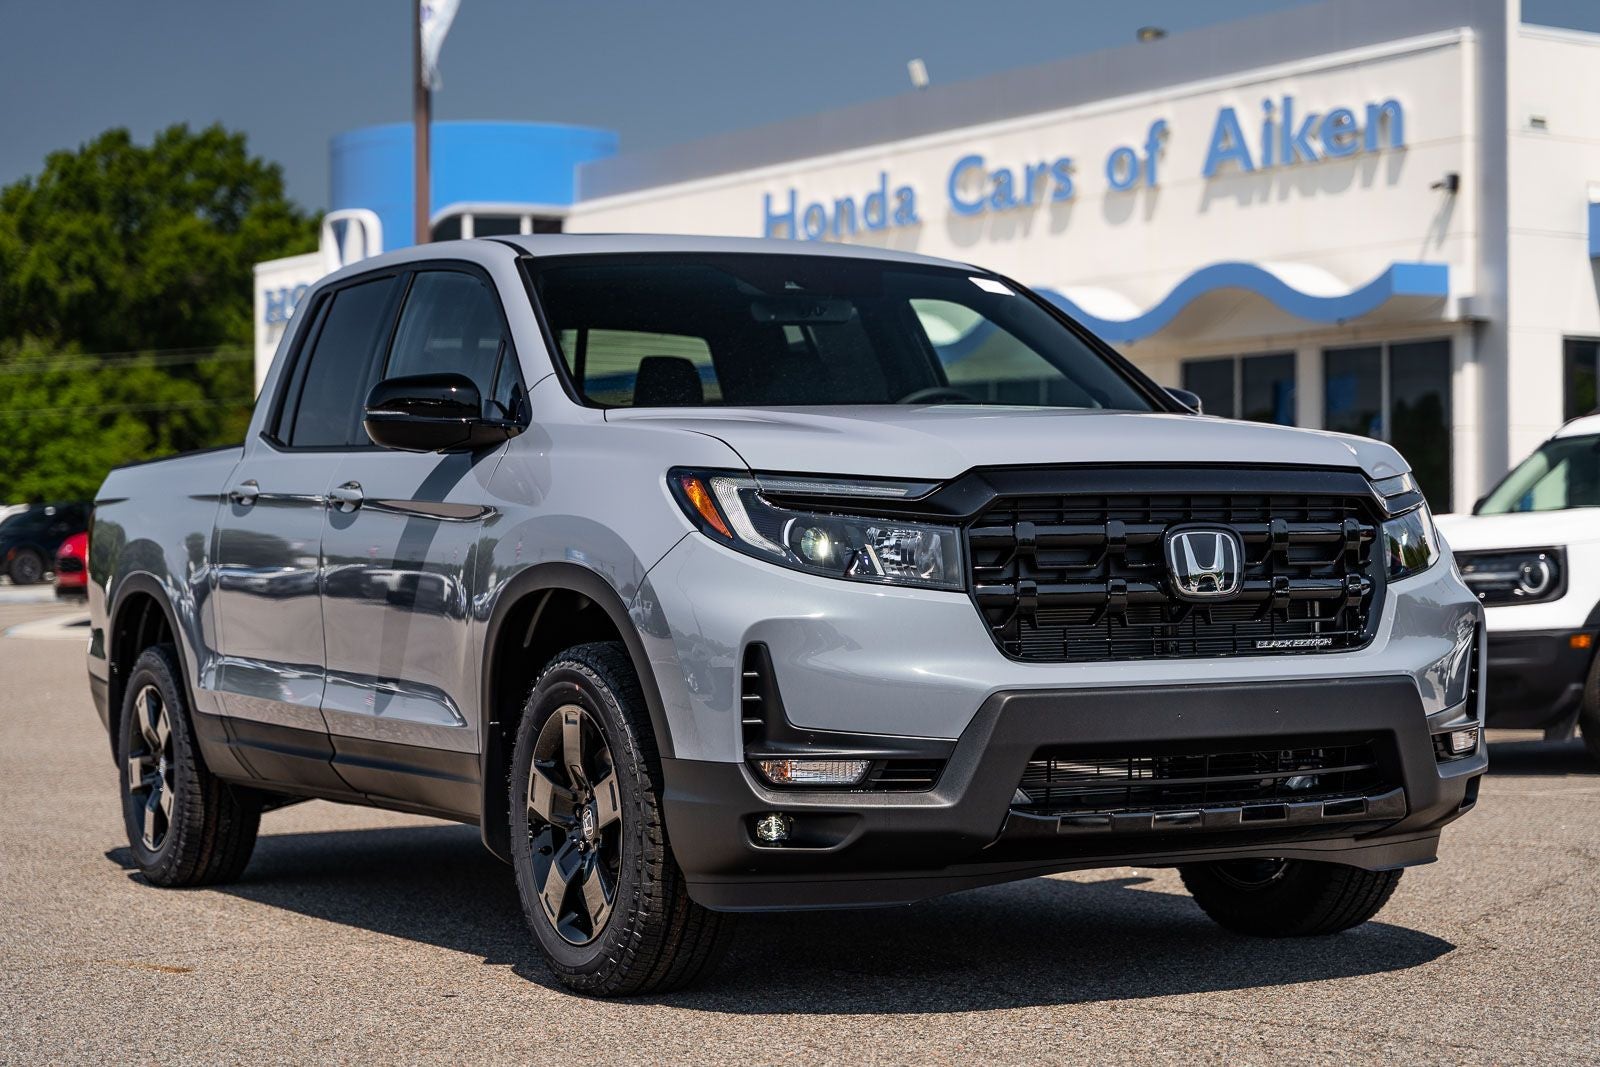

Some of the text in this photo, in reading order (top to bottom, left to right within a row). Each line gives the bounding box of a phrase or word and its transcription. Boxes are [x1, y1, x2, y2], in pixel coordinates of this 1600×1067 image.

[764, 95, 1406, 241] Honda Cars of Aiken
[1255, 637, 1333, 649] BLACK EDITION
